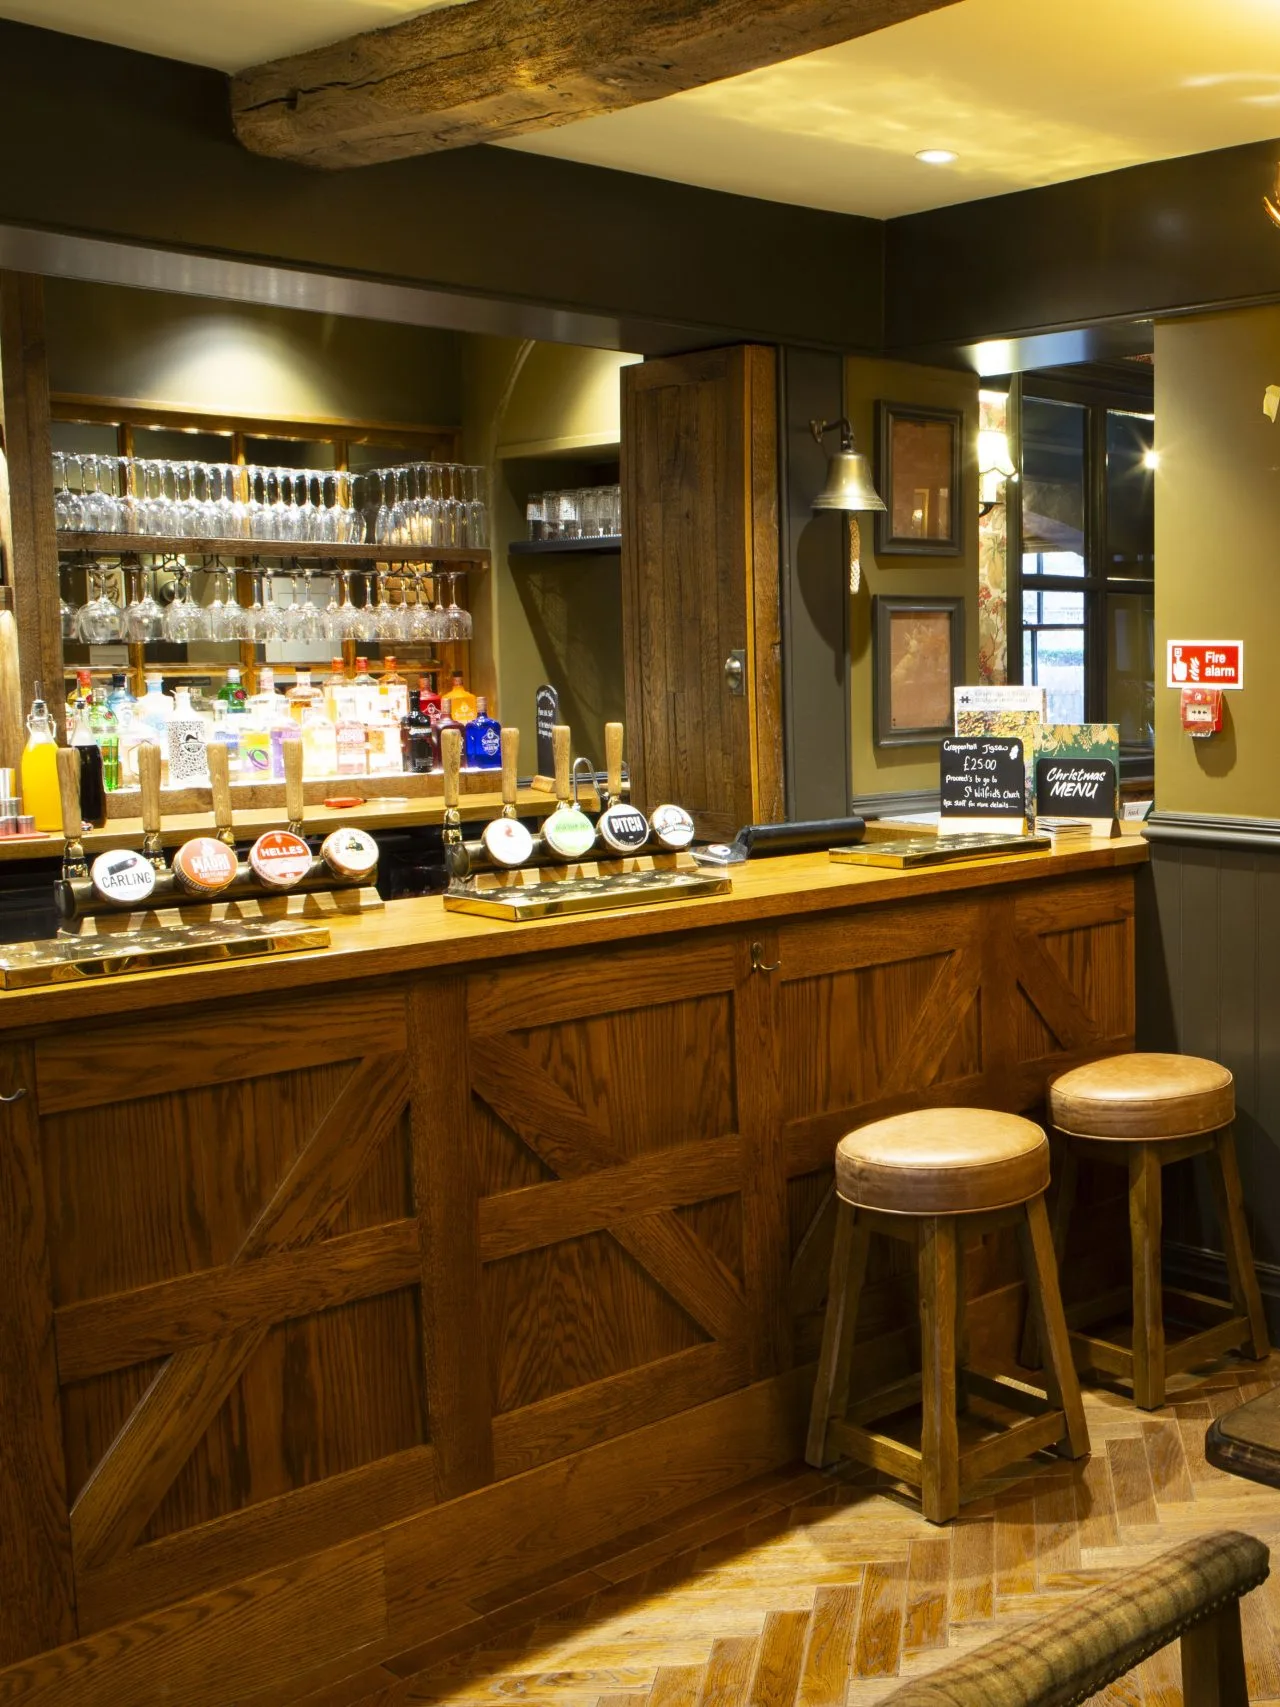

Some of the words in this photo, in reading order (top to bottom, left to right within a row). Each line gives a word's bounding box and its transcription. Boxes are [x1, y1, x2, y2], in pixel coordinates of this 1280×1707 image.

[1205, 651, 1226, 664] Fire
[1204, 664, 1235, 677] alarm
[982, 744, 1009, 754] Jigsaw
[975, 774, 981, 783] to
[982, 777, 990, 786] go
[991, 774, 998, 783] to
[1046, 767, 1106, 782] Christmas
[1050, 781, 1099, 799] MENU
[610, 815, 644, 833] PITCH
[260, 845, 304, 857] HELLES
[101, 871, 152, 889] CARLING
